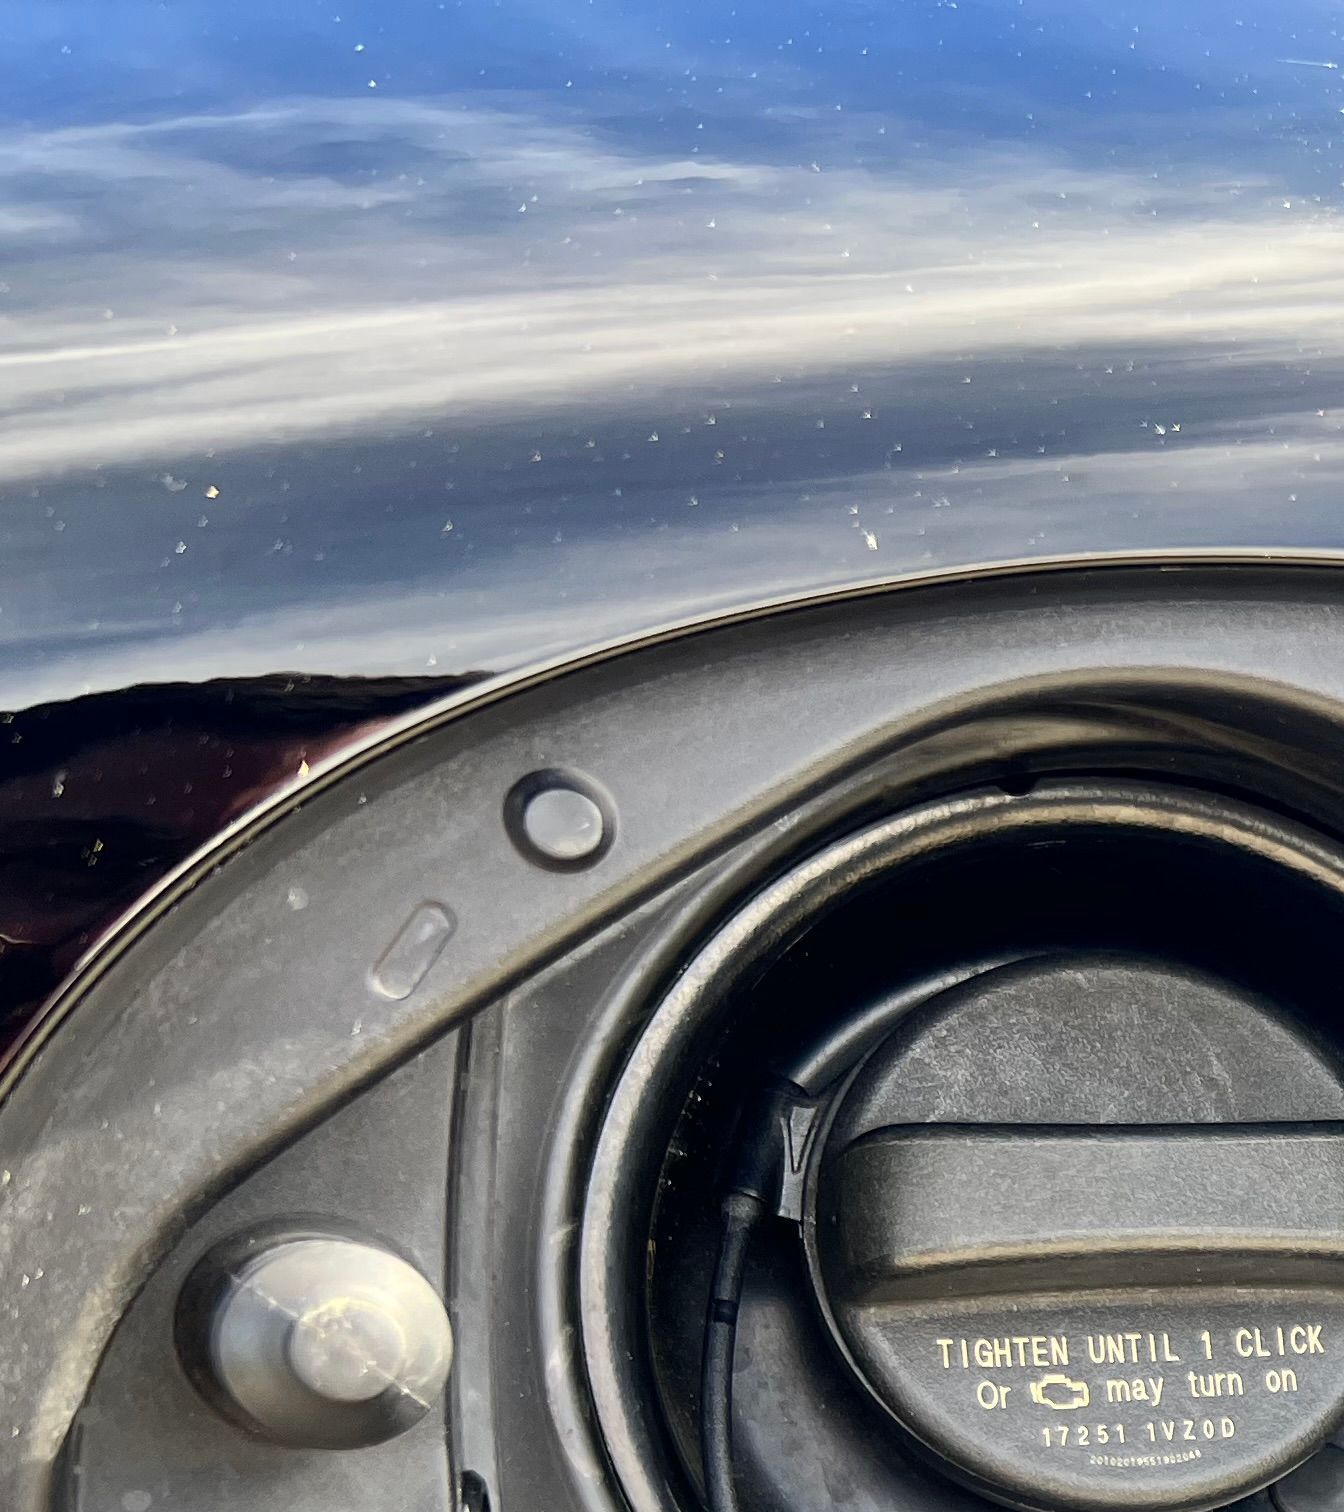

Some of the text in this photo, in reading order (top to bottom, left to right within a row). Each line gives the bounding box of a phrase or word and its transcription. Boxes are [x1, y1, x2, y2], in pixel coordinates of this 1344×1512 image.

[936, 1325, 1325, 1368] TIGHTEN UNTIL 1 CLICK
[976, 1369, 1298, 1410] Or may turn on
[1042, 1423, 1127, 1447] 17251
